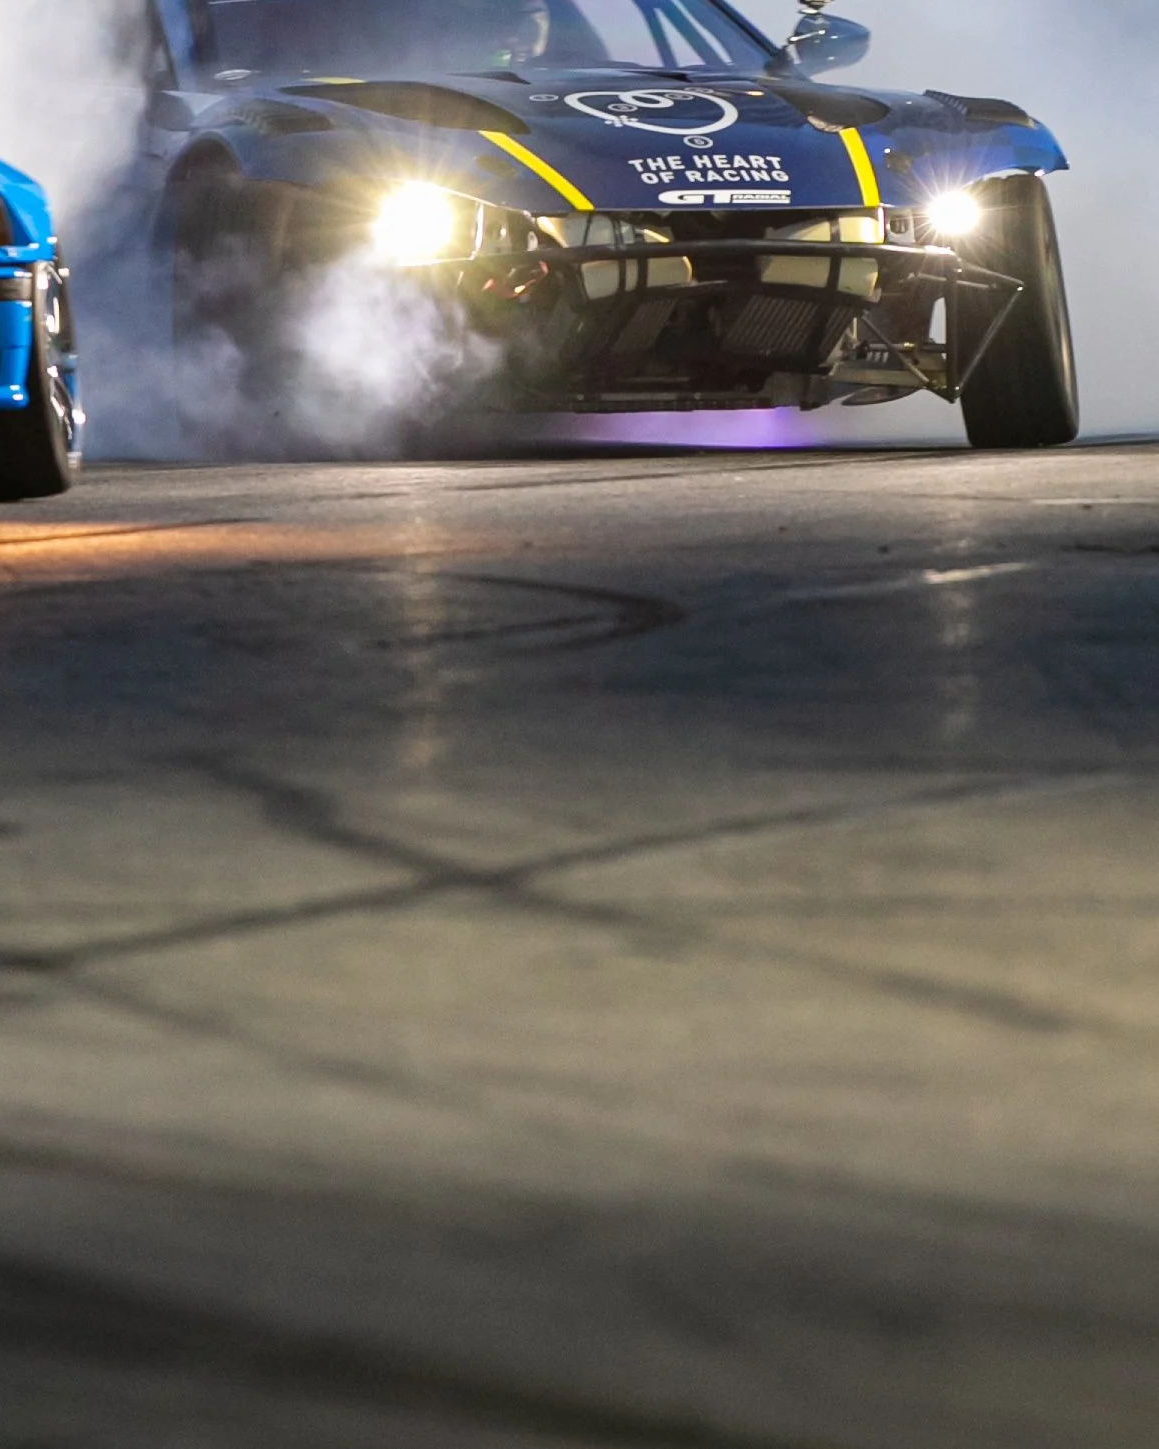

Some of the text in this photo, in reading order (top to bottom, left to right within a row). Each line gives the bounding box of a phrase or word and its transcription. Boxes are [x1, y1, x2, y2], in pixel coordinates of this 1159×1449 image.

[628, 154, 782, 173] THE HEART
[641, 169, 789, 184] OF RACING
[658, 190, 745, 204] GT
